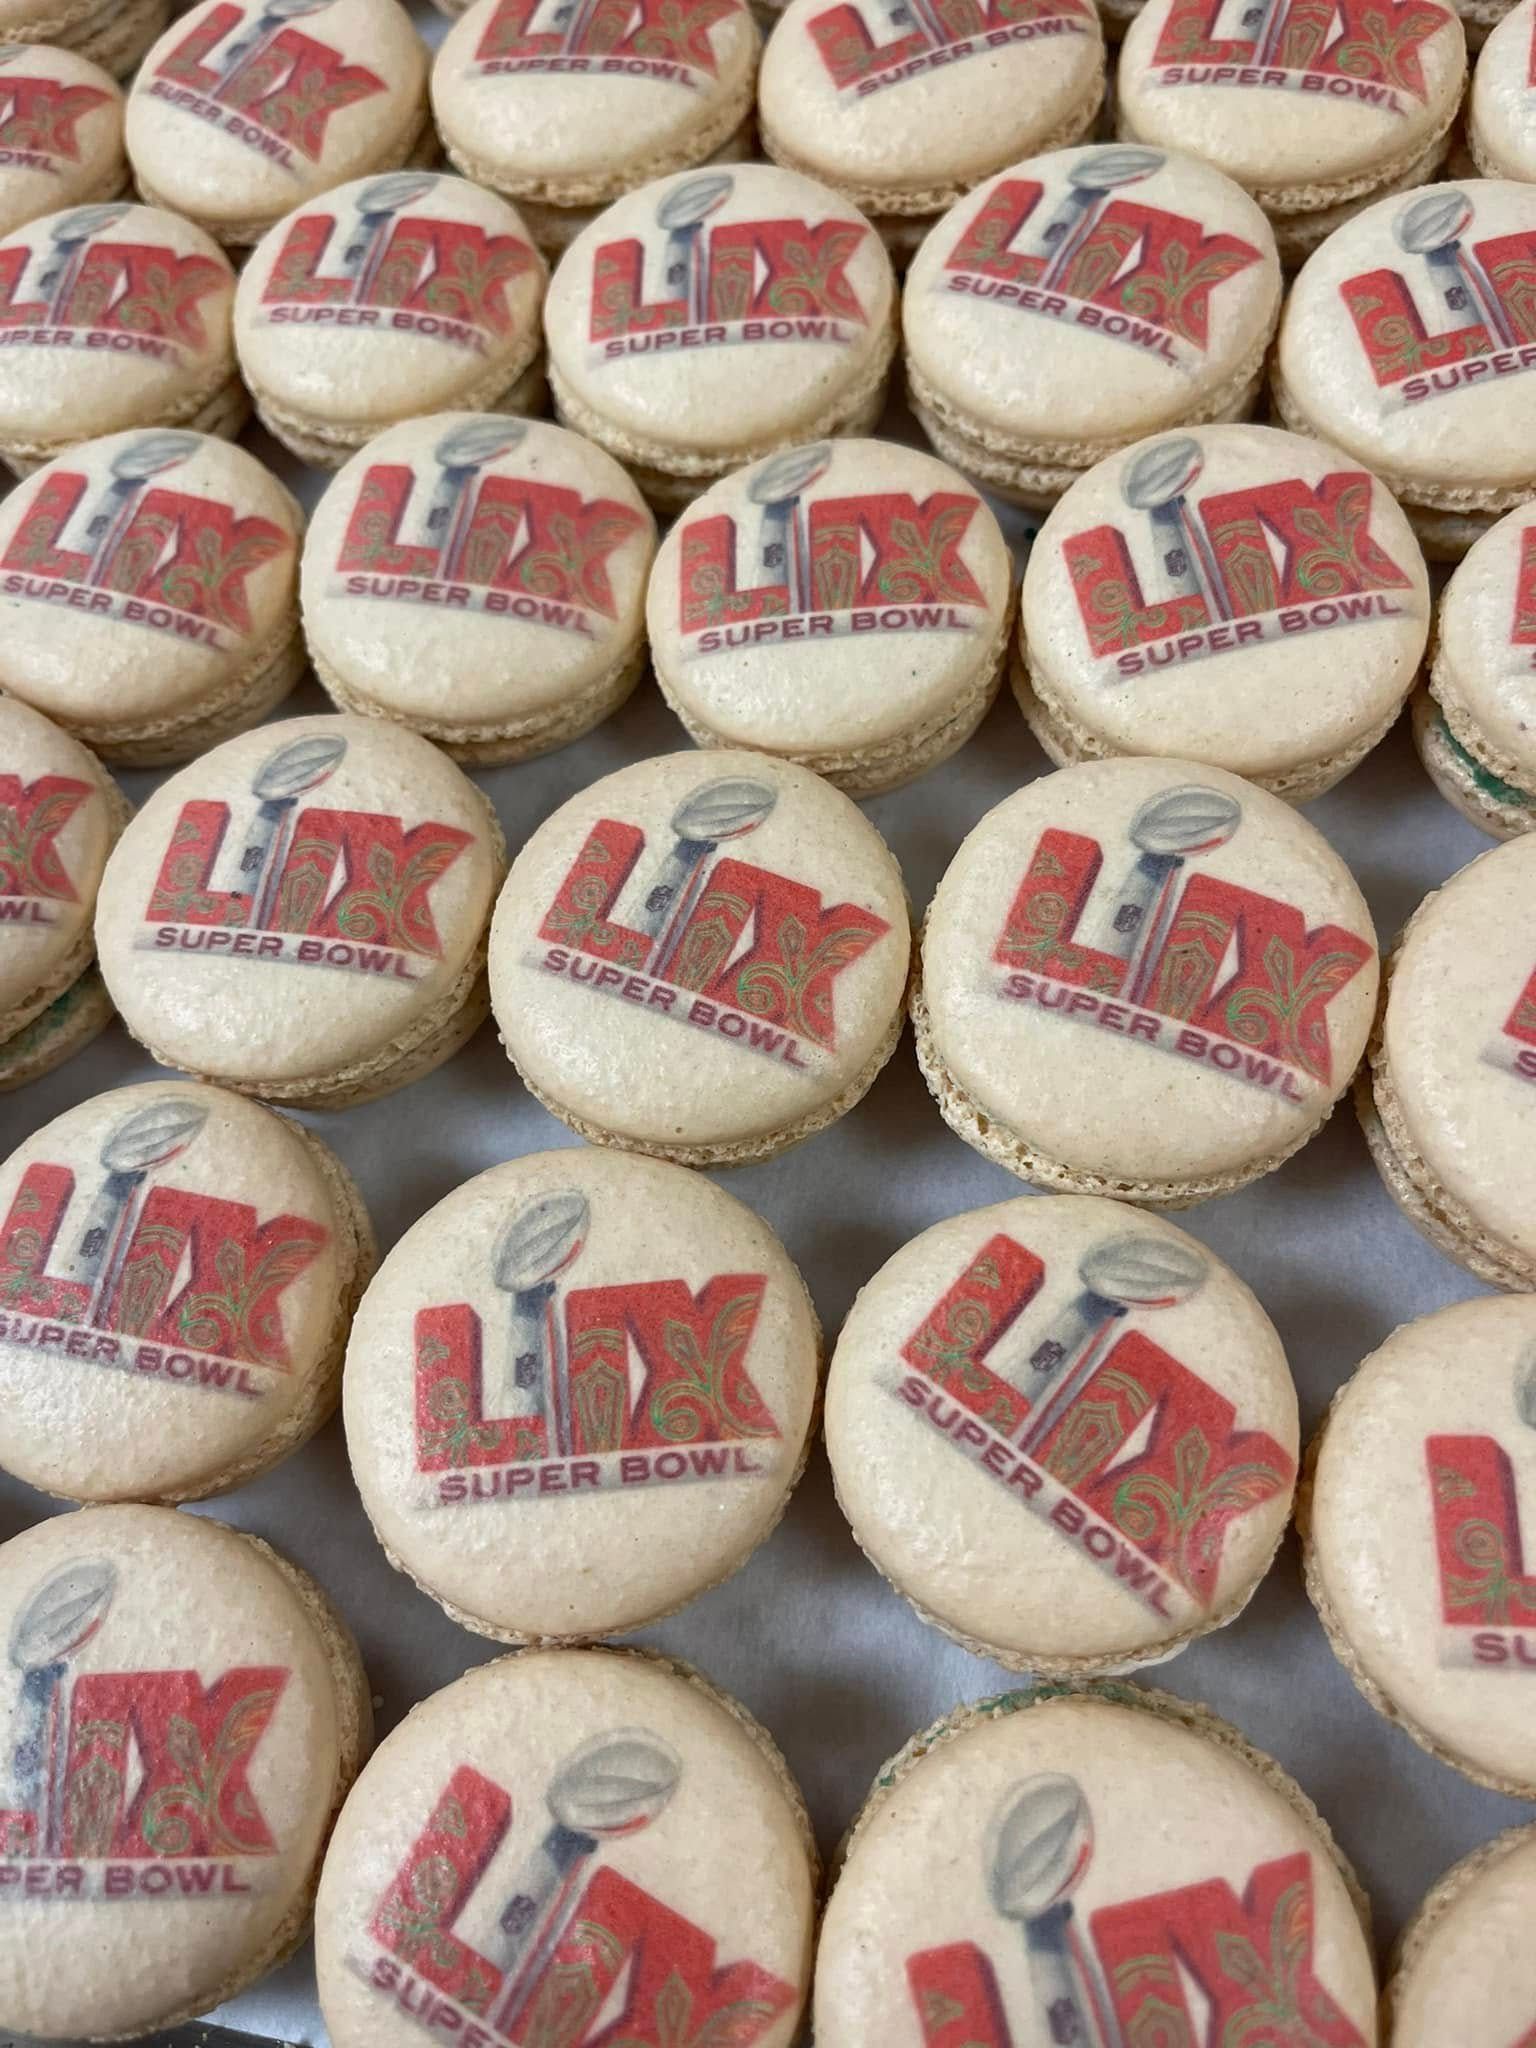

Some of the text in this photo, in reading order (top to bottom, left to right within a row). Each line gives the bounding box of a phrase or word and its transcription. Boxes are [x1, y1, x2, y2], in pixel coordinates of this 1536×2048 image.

[481, 58, 698, 88] SUPER BOWL
[857, 18, 1089, 97] SUPER BOWL
[1161, 67, 1409, 117] SUPER BOWL
[150, 80, 223, 121] SUPER
[224, 117, 297, 172] BOWL
[0, 150, 60, 175] OWL
[269, 305, 489, 356] SUPER BOWL
[604, 320, 853, 359] SUPER BOWL
[947, 275, 1180, 364] SUPER BOWL
[0, 330, 185, 369] PER BOWL
[3, 575, 231, 652] SUPER BOWL
[346, 576, 598, 640] SUPER BOWL
[698, 608, 971, 653] SUPER BOWL
[1116, 595, 1404, 677] SUPER BOWL
[155, 927, 422, 981] SUPER BOWL
[543, 948, 809, 1068] SUPER BOWL
[1001, 973, 1305, 1103] SUPER BOWL
[134, 1346, 267, 1397] BOWL
[439, 1448, 764, 1505] SUPER BOWL
[899, 1375, 1171, 1621] SUPER BOWL
[0, 1864, 251, 1896] PER BOWL
[373, 1957, 508, 2048] SUPE
